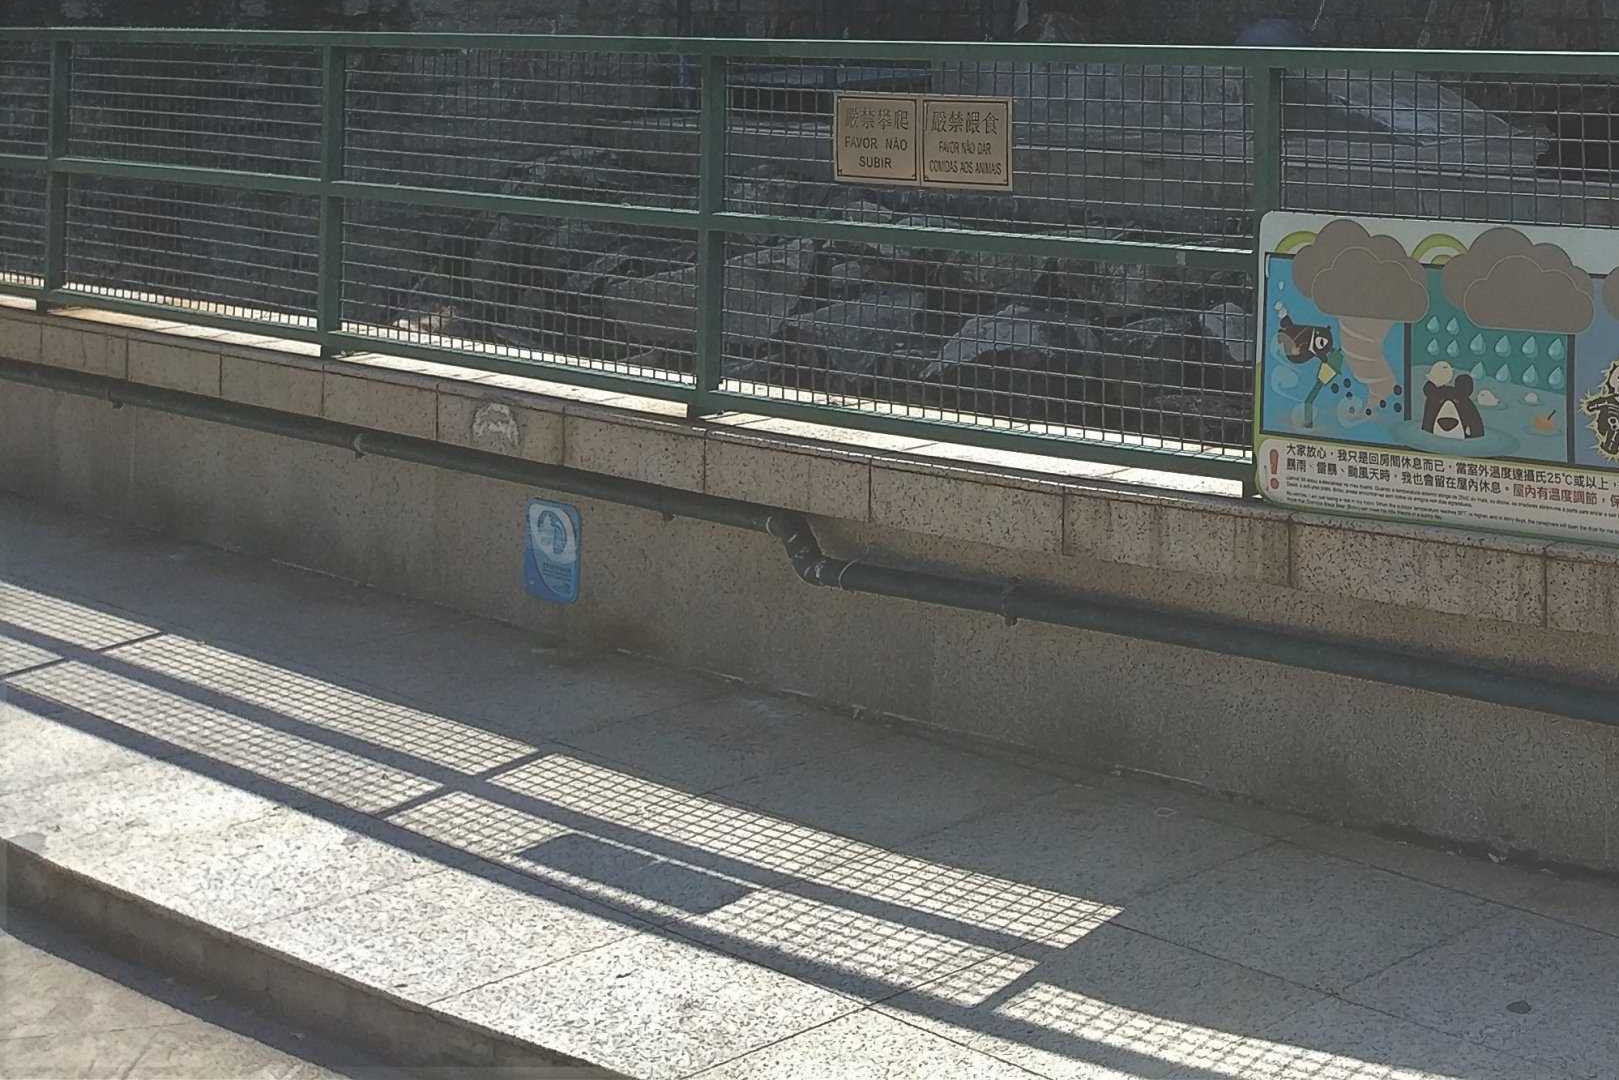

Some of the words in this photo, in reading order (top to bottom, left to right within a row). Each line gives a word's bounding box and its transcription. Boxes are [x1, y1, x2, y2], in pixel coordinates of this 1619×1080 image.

[844, 136, 878, 150] FAVOR
[885, 137, 908, 151] NÃO
[938, 141, 960, 153] FAVOR
[961, 140, 976, 155] NÃO
[977, 142, 991, 155] DAR
[859, 156, 892, 169] SUBIR
[929, 159, 958, 174] COMIDAS
[960, 161, 974, 174] AOS
[975, 161, 1002, 176] ANIMAIS
